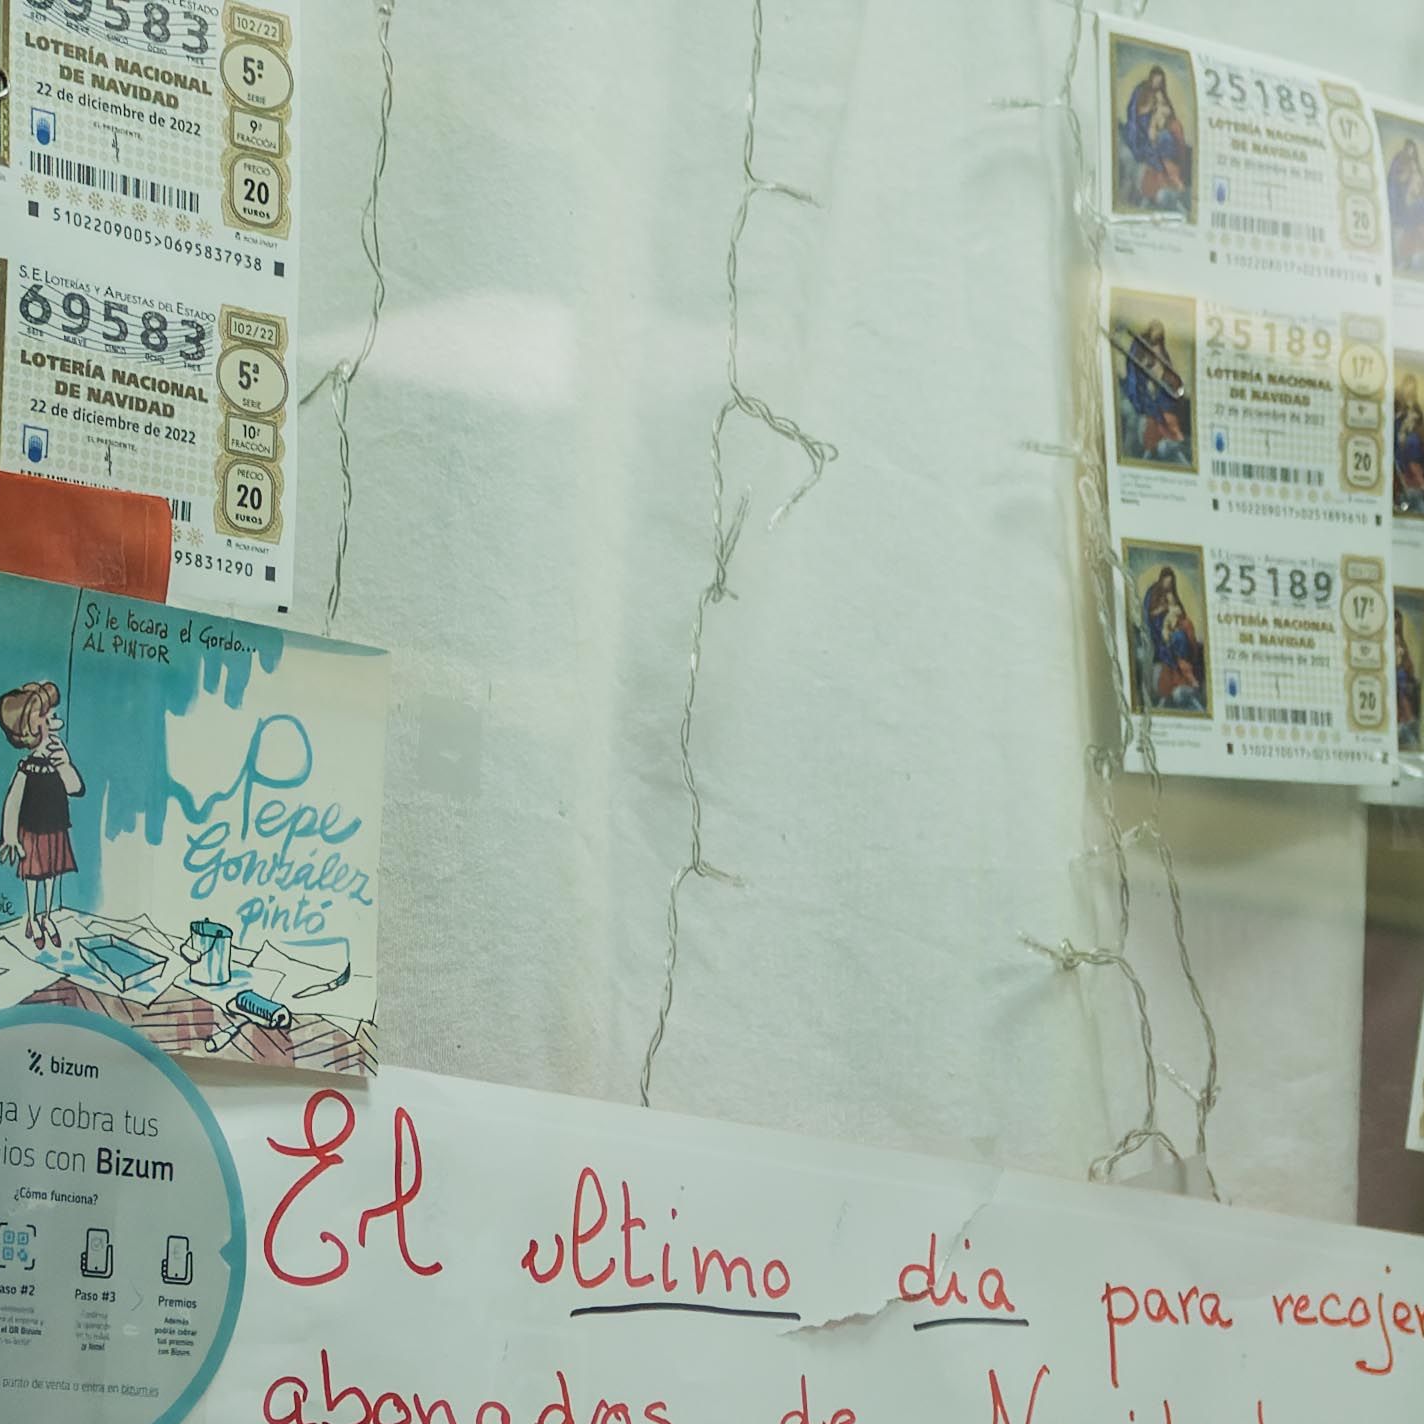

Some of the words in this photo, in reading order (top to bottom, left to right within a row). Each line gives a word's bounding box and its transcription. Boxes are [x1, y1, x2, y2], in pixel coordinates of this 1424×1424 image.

[1204, 68, 1319, 120] 25189
[242, 177, 269, 205] 20
[18, 283, 207, 362] 69583
[1206, 316, 1332, 361] 25189
[236, 483, 262, 509] 20
[1214, 563, 1332, 601] 25189
[83, 632, 106, 654] AL
[111, 635, 171, 664] PINTOR
[50, 1056, 99, 1079] bizum
[27, 1101, 41, 1130] y
[51, 1101, 114, 1132] cobra
[125, 1110, 159, 1136] tus
[45, 1150, 85, 1172] con
[96, 1147, 174, 1182] Bizum
[263, 1089, 442, 1288] El
[521, 1166, 791, 1298] ultimo
[898, 1232, 1016, 1312] dia
[1102, 1281, 1234, 1387] para
[21, 1284, 35, 1296] #2
[75, 1288, 99, 1302] Paso
[102, 1290, 116, 1302] #3
[158, 1296, 197, 1310] Premios
